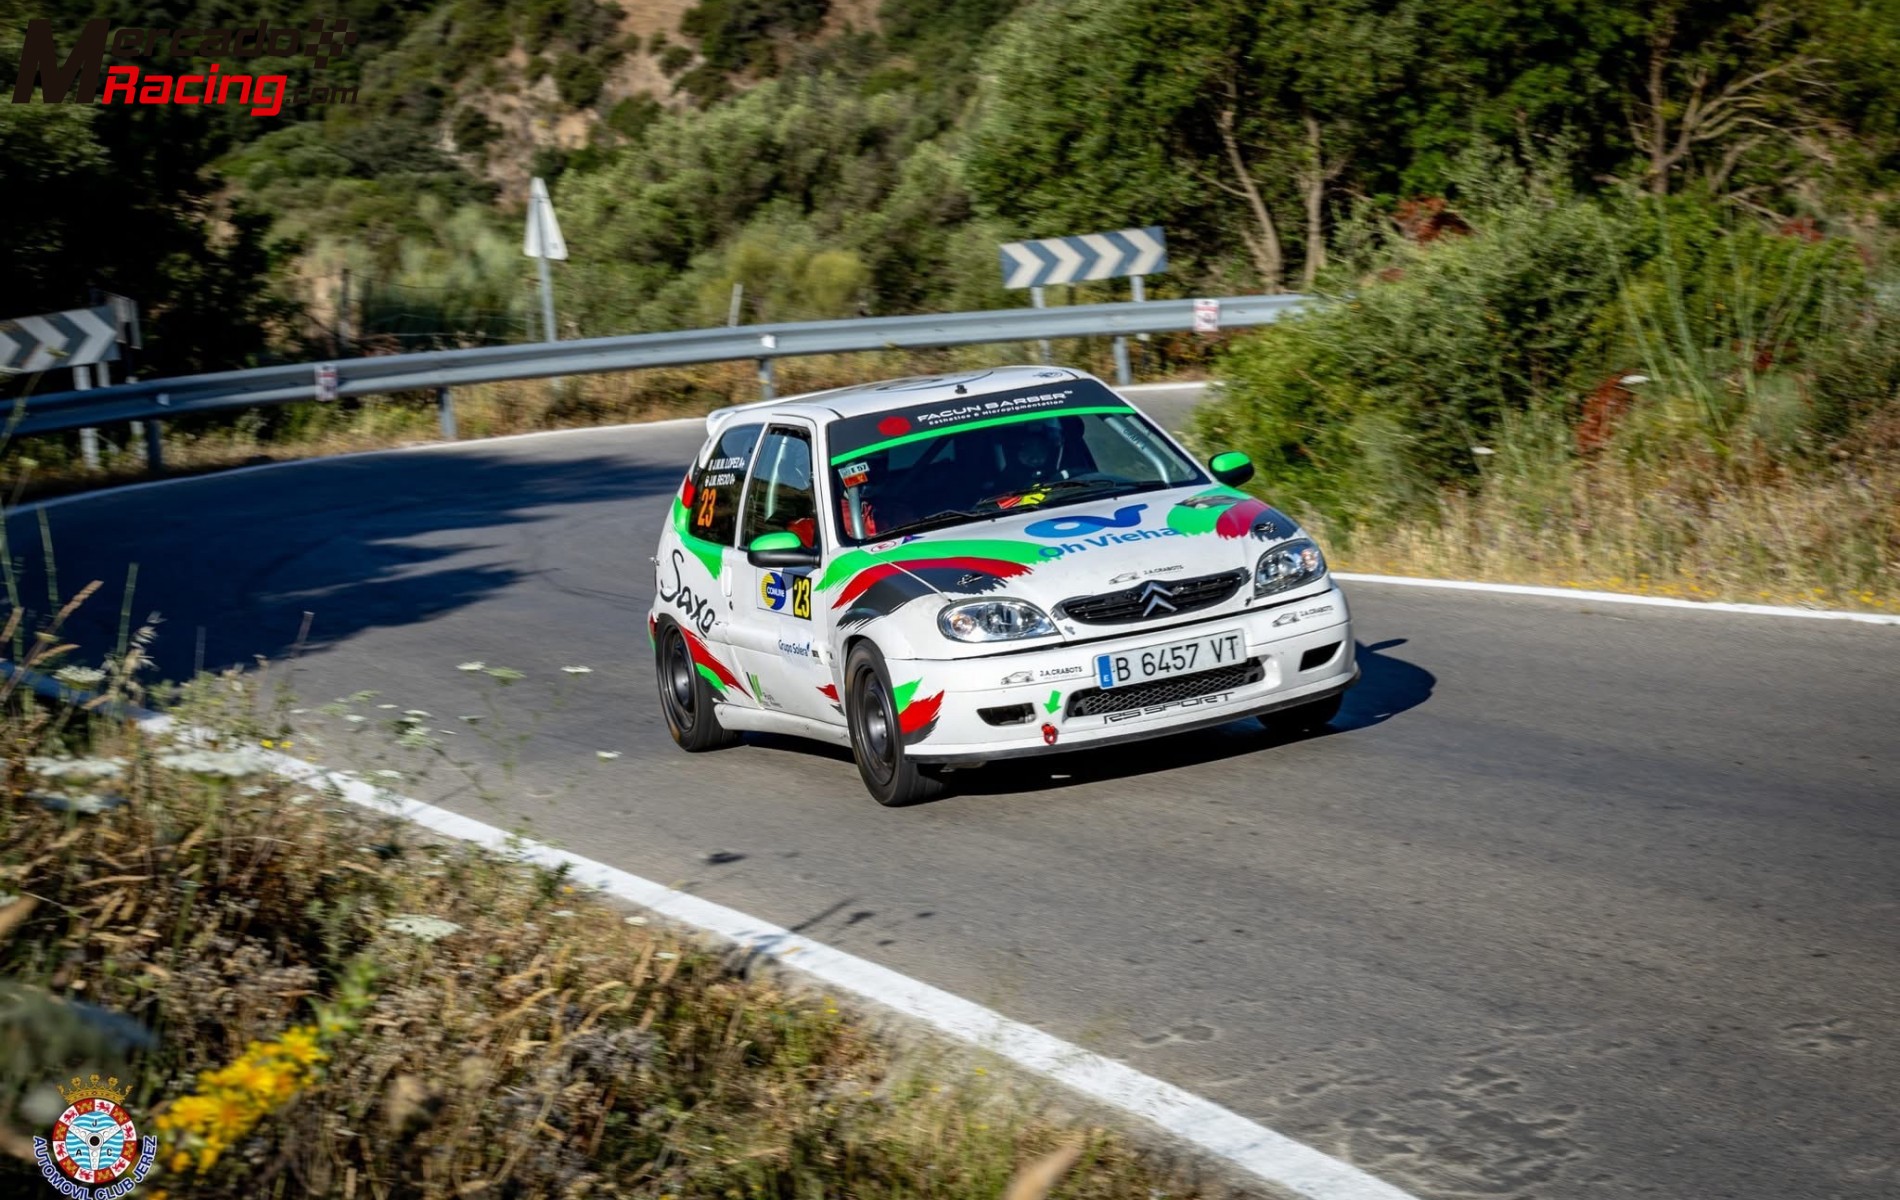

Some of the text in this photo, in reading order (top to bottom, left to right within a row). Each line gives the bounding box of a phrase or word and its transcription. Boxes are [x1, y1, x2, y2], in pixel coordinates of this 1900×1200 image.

[917, 404, 982, 423] FACUN
[697, 488, 717, 527] 23
[1039, 526, 1178, 558] Oh Vieha
[793, 578, 810, 618] 23
[1115, 635, 1238, 682] B 6457 VT
[1103, 691, 1236, 724] RS SPORT
